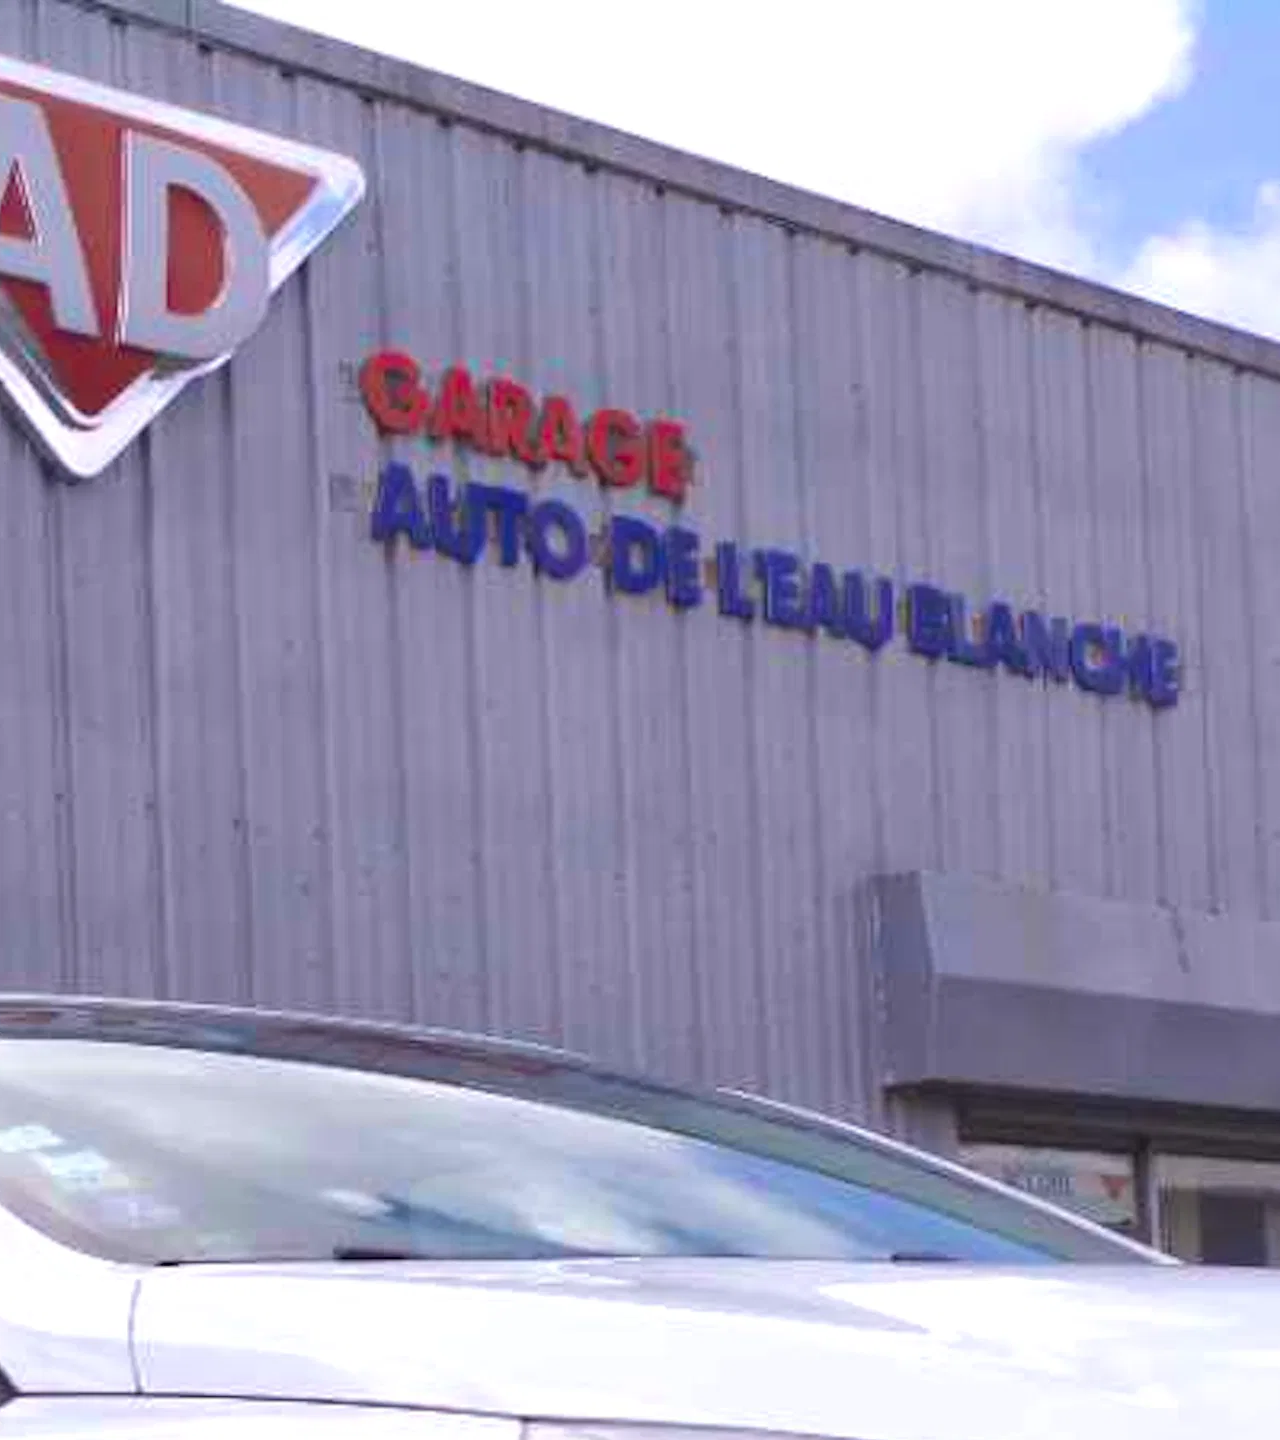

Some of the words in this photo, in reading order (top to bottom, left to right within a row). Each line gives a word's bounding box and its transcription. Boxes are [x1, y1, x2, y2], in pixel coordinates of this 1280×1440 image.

[361, 351, 690, 498] GARAGE
[374, 461, 589, 579] AUTO
[610, 514, 702, 608] DE
[718, 543, 893, 651] L'EAU
[909, 584, 1180, 707] BLANCHE
